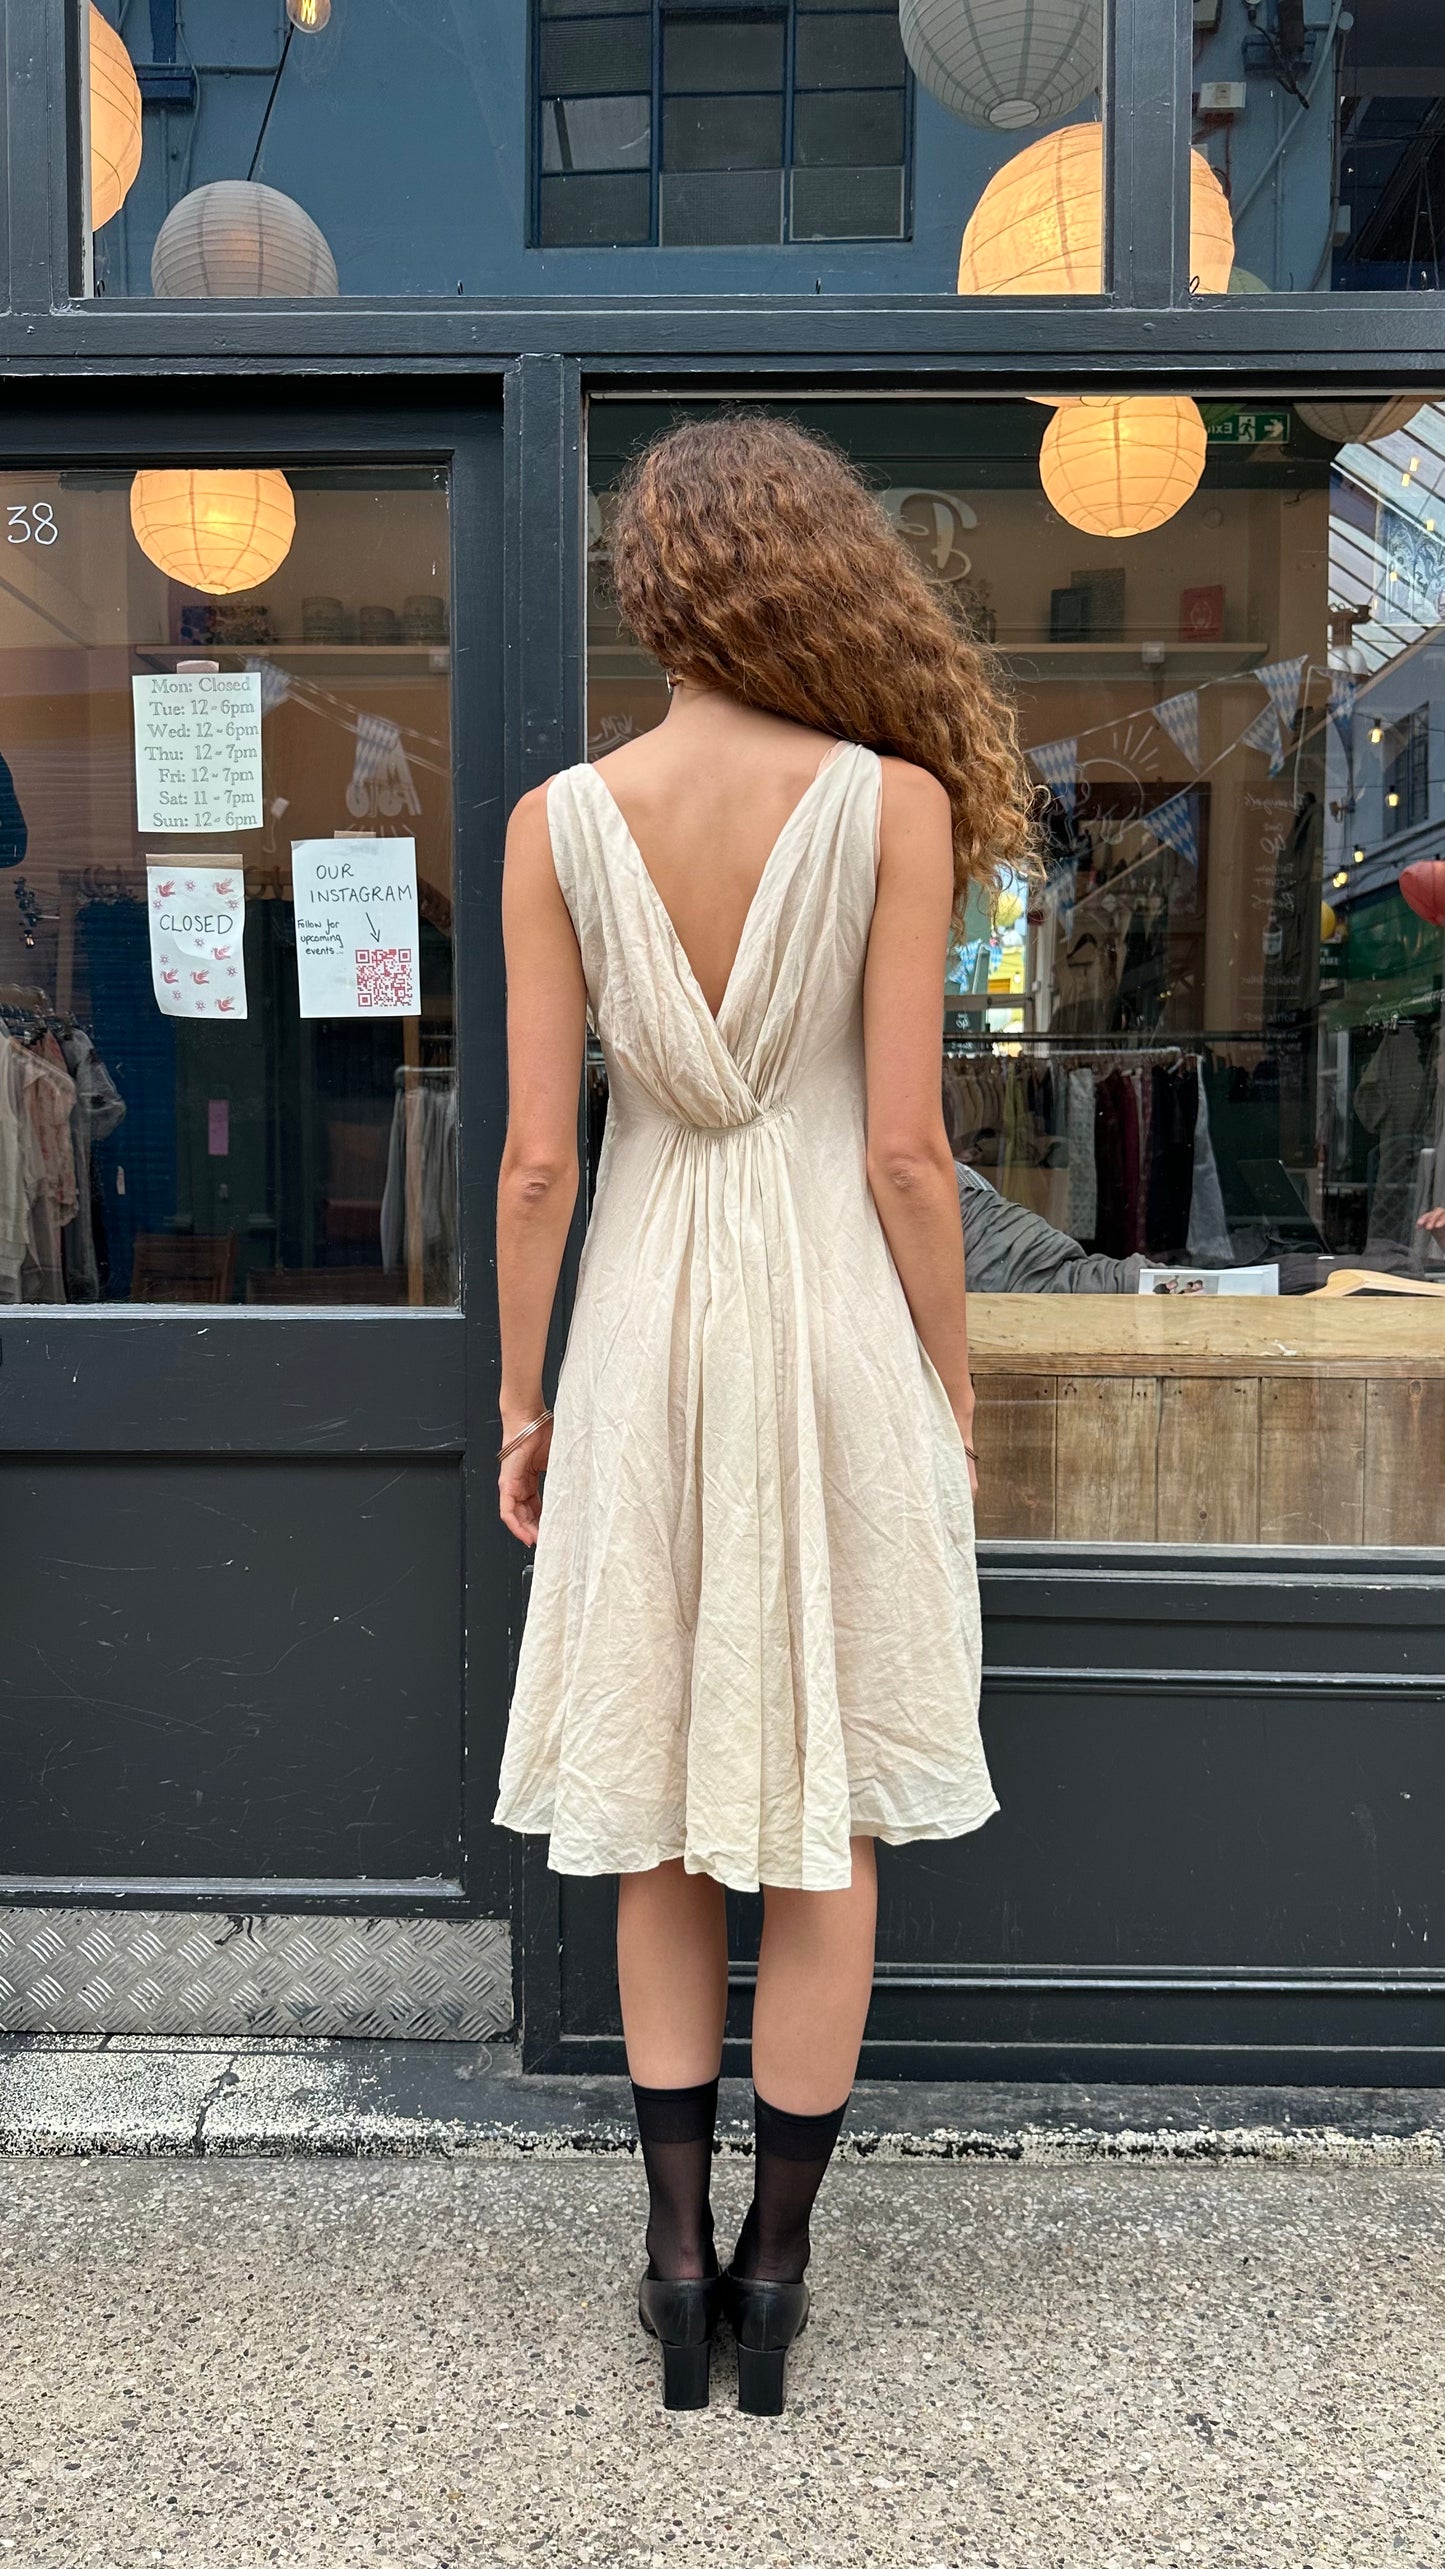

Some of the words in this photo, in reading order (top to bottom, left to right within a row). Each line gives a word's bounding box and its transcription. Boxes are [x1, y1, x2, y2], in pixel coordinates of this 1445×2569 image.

[6, 502, 58, 545] 38
[151, 678, 193, 694] Mon:
[198, 676, 251, 692] Closed
[149, 701, 185, 716] Tue:
[147, 723, 191, 738] Wed:
[144, 746, 184, 761] Thu:
[158, 768, 186, 783] Fri:
[159, 790, 188, 805] Sat:
[153, 812, 189, 828] Sun:
[316, 863, 354, 879] OUR
[310, 884, 413, 903] INSTAGRAM
[160, 914, 233, 934] CLOSED
[297, 919, 322, 929] Follow
[325, 918, 340, 935] for
[300, 934, 344, 949] upcoming
